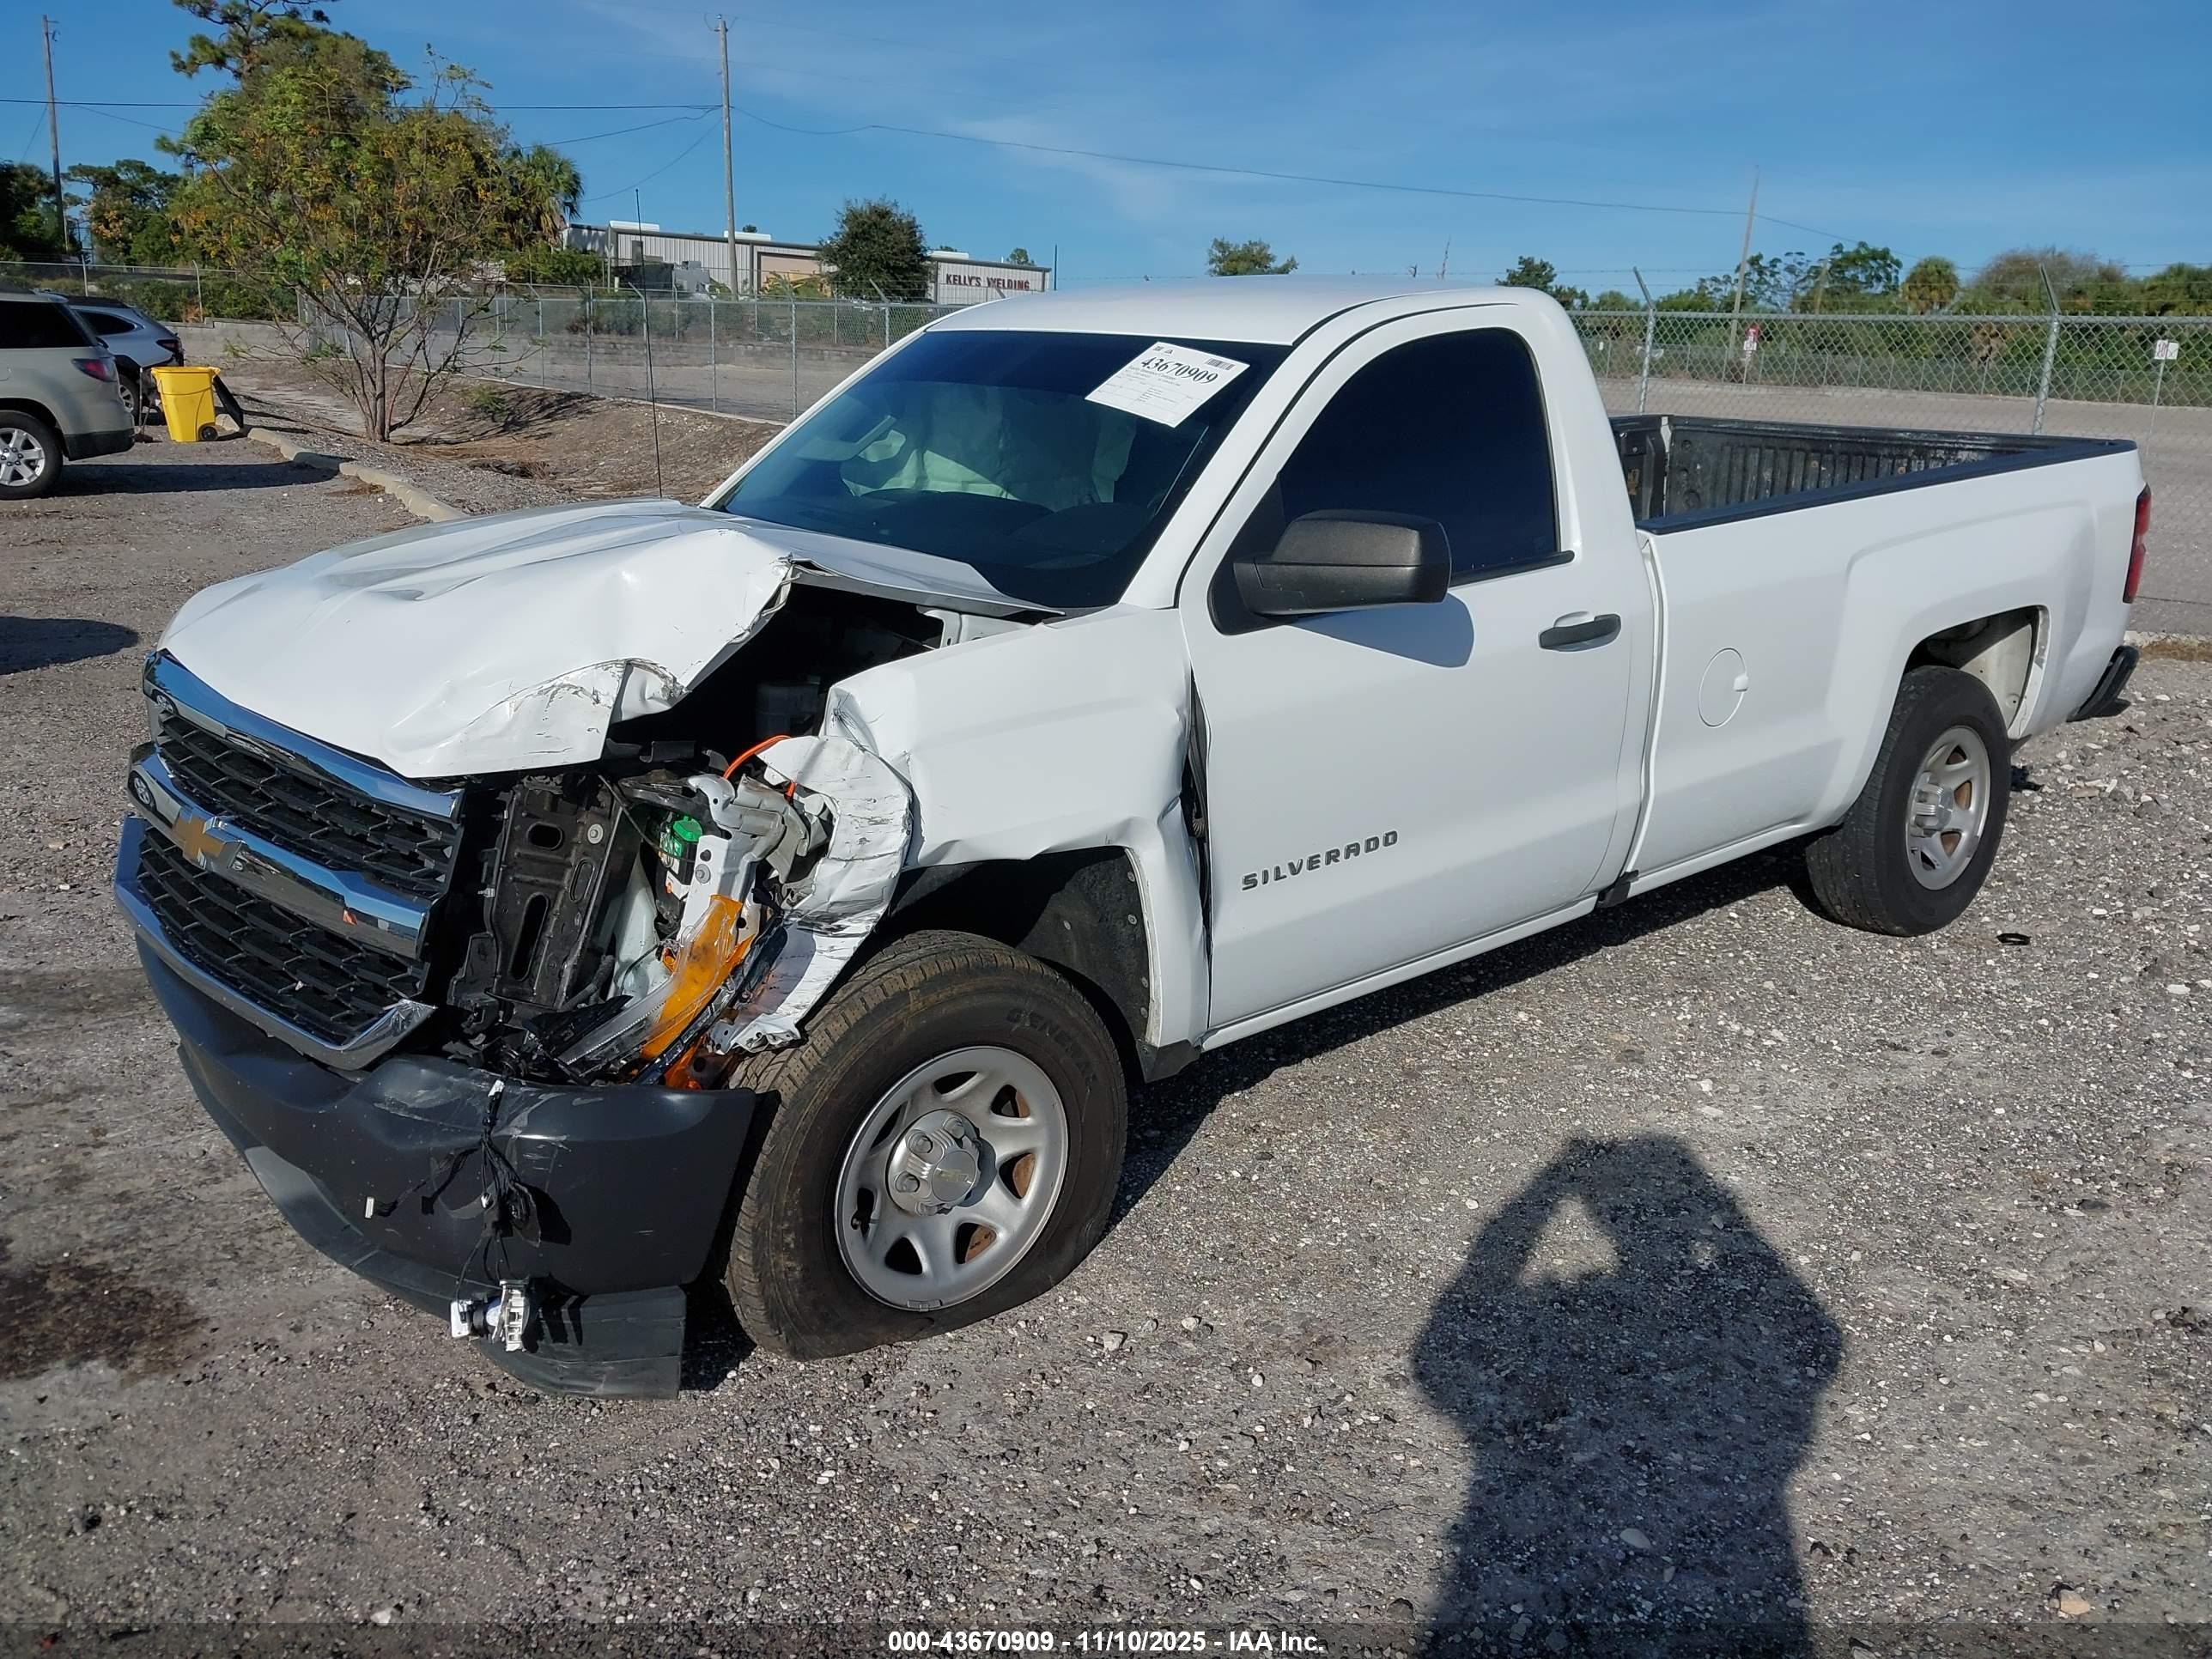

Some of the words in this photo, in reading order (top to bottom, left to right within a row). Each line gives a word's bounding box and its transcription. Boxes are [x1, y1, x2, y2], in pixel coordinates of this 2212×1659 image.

[945, 273, 981, 287] KELLY'S
[987, 276, 1030, 291] WELDING
[1141, 356, 1218, 385] 43670909
[1242, 830, 1398, 890] SILVERADO
